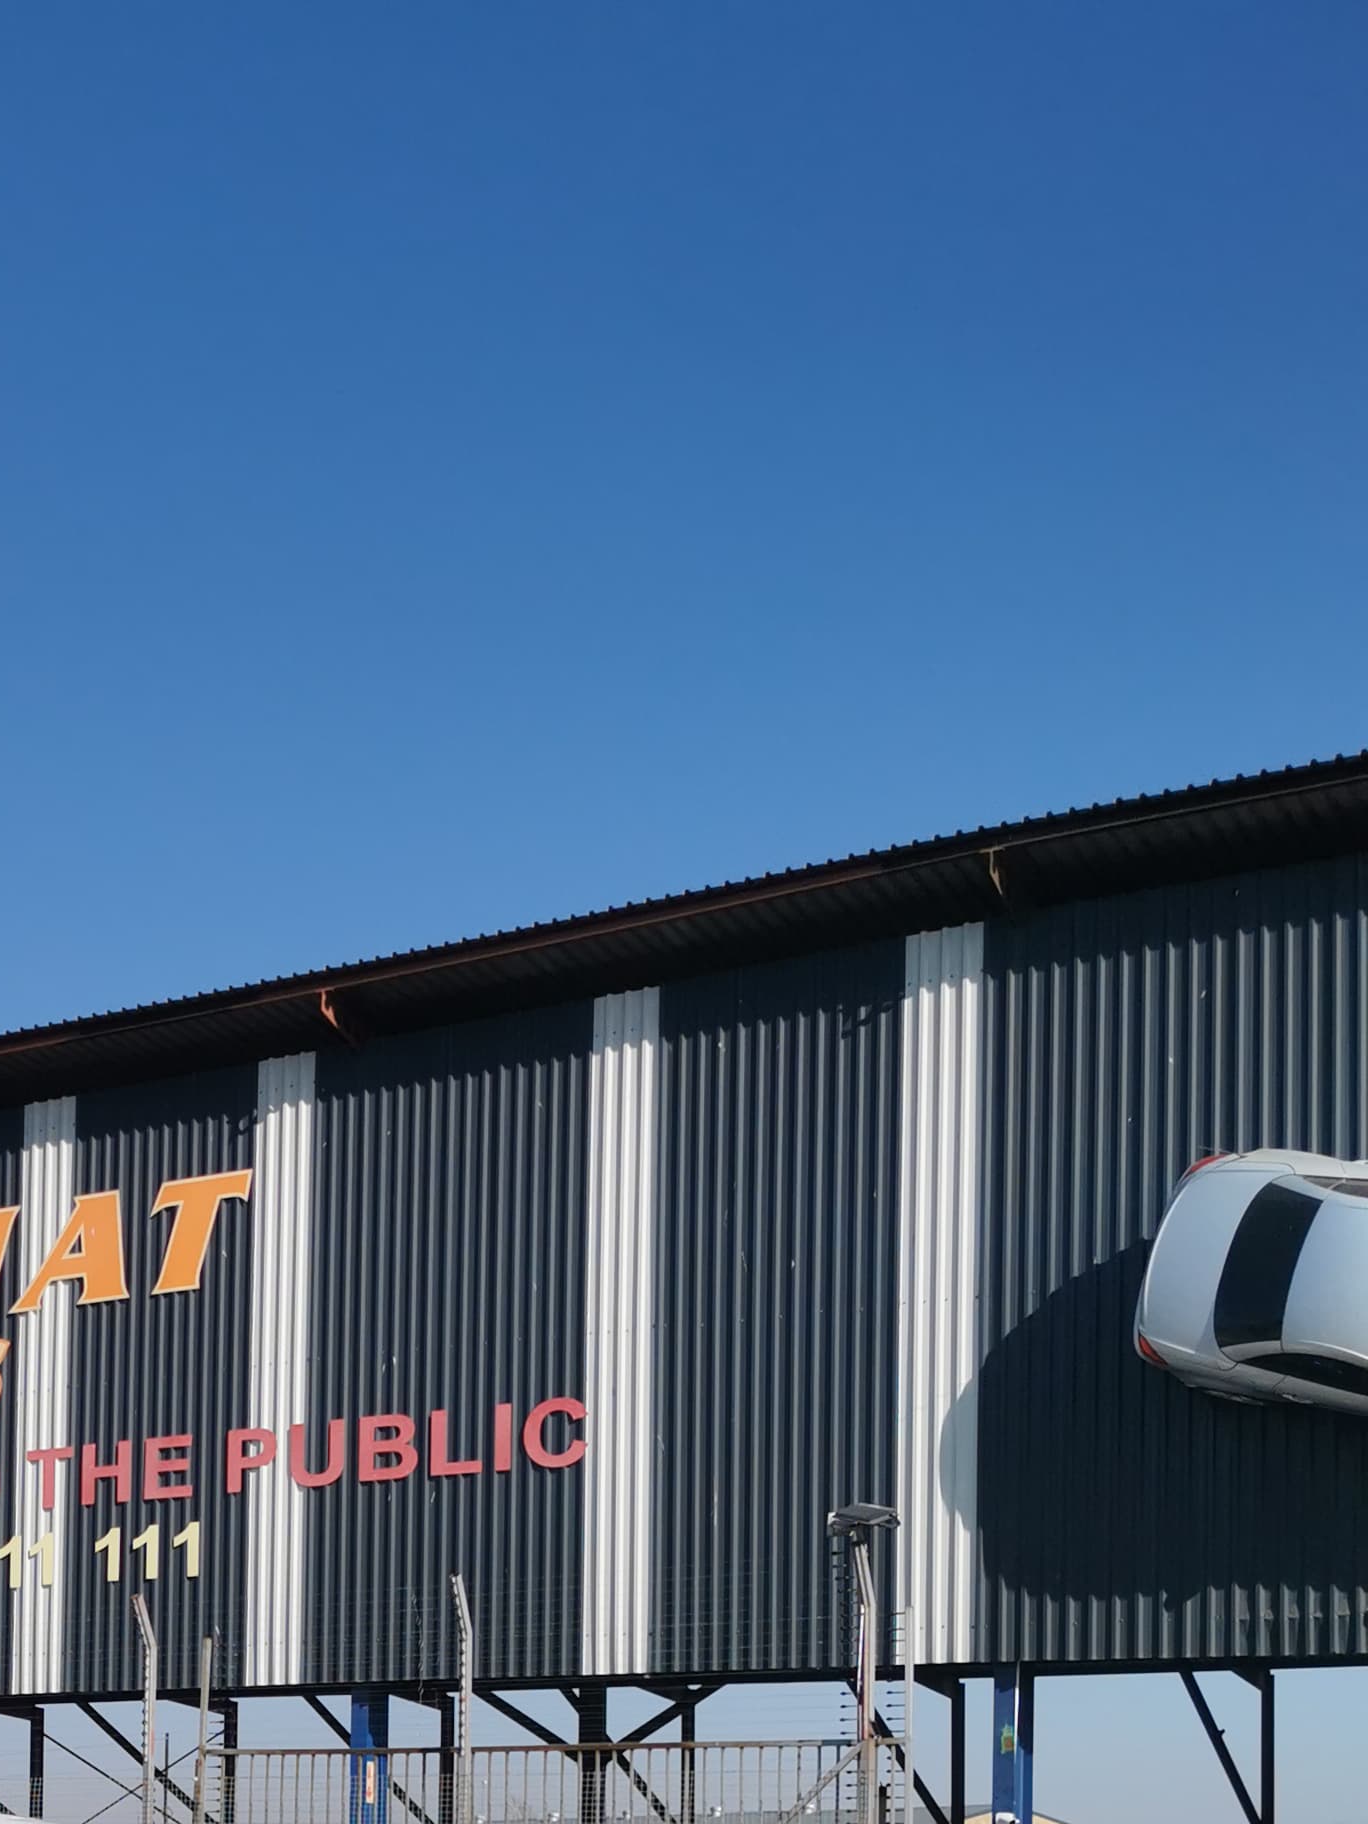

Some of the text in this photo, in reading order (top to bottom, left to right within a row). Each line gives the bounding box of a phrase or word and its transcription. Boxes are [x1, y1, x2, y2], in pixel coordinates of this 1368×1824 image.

[27, 1433, 194, 1510] THE
[226, 1396, 589, 1495] PUBLIC
[93, 1520, 201, 1583] 111
